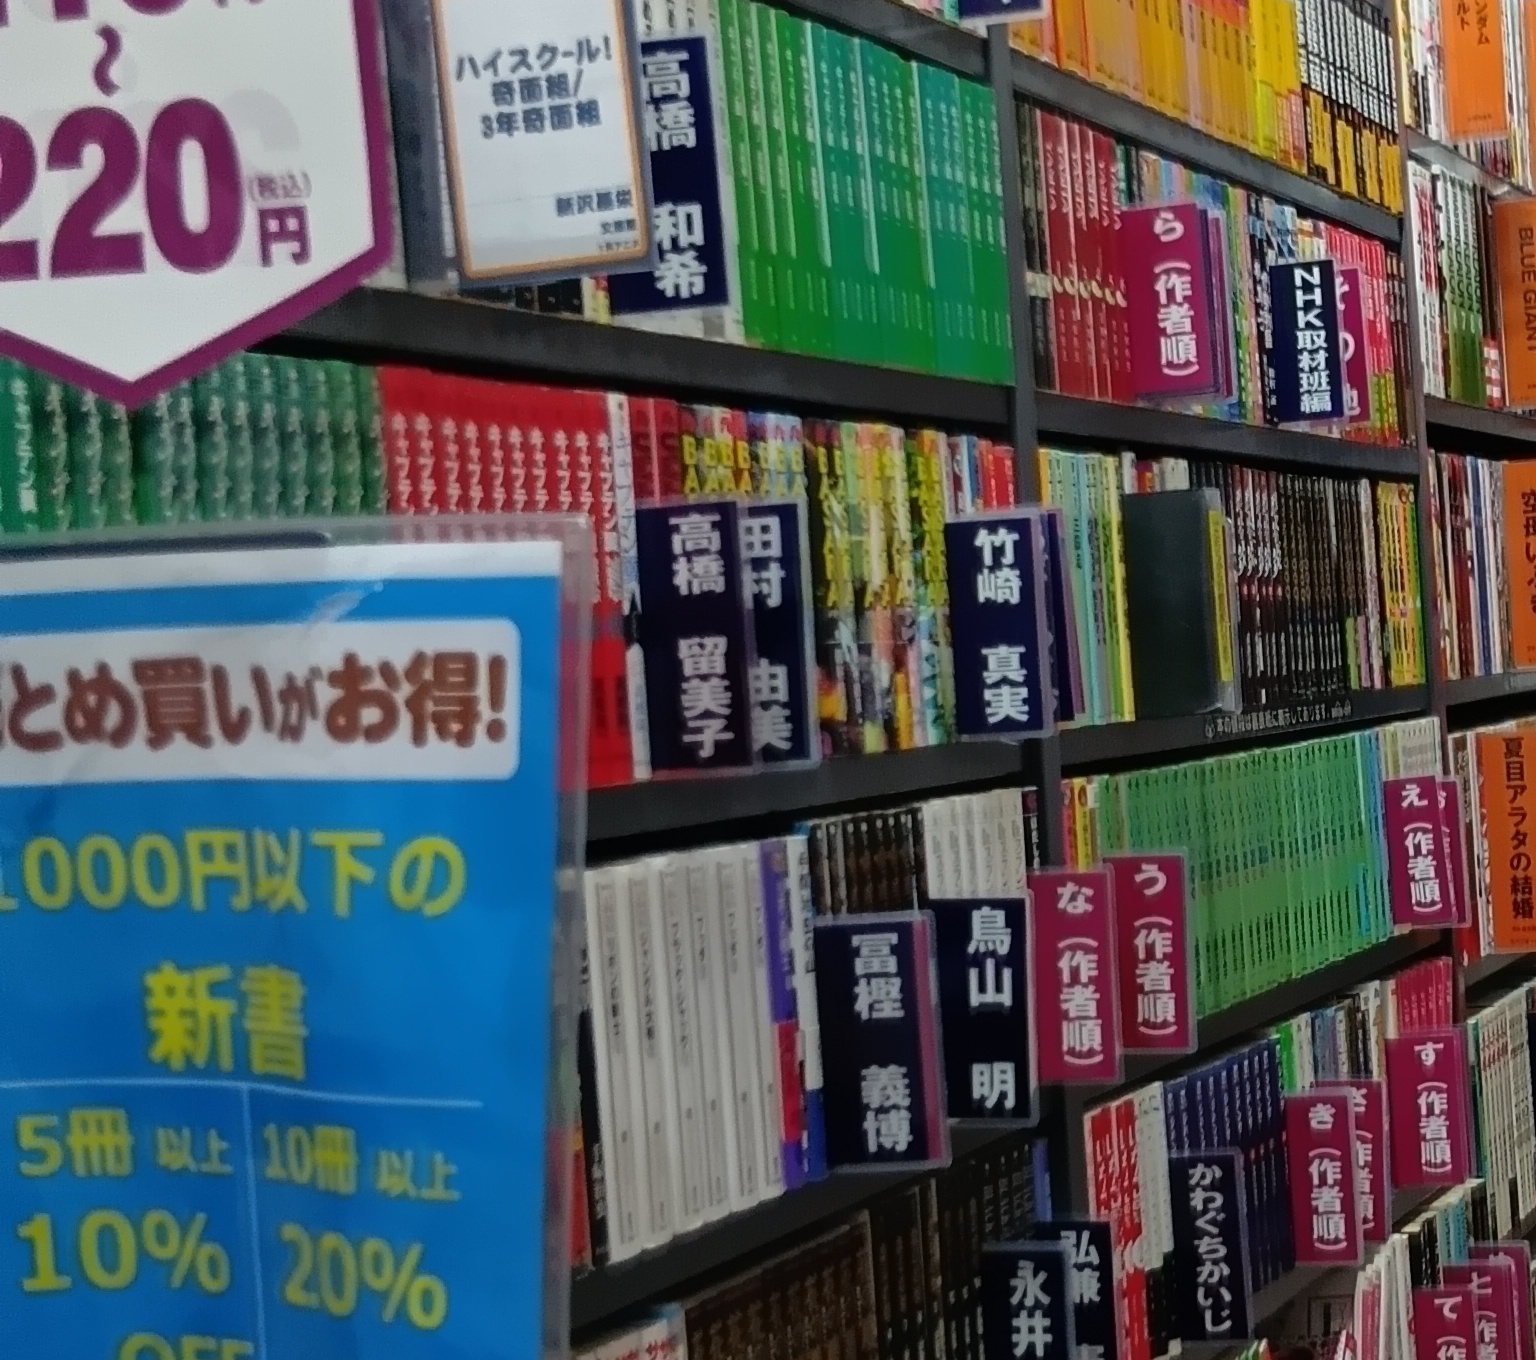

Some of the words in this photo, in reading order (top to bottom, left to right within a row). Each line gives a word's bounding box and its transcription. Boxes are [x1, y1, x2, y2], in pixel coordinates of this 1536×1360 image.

[257, 205, 312, 267] 円
[1154, 211, 1199, 376] ら（作者順）
[1519, 226, 1536, 284] BLUE
[1294, 266, 1333, 414] NHK取材班編
[0, 650, 509, 754] とめ買いがお得!
[1400, 783, 1442, 916] え（作者順）
[1056, 882, 1104, 1066] な（作者順）
[1134, 862, 1178, 1038] う（作者順）
[143, 961, 308, 1082] 新書
[16, 1110, 134, 1177] 5冊
[156, 1127, 233, 1175] 以上
[262, 1122, 359, 1195] 10冊
[376, 1149, 461, 1202] 以上
[1414, 1041, 1453, 1176] す（作者順）
[1308, 1102, 1348, 1251] き（作者順）
[17, 1209, 231, 1293] 10%
[279, 1223, 448, 1330] 20%
[1187, 1162, 1235, 1332] かわぐちかいじ
